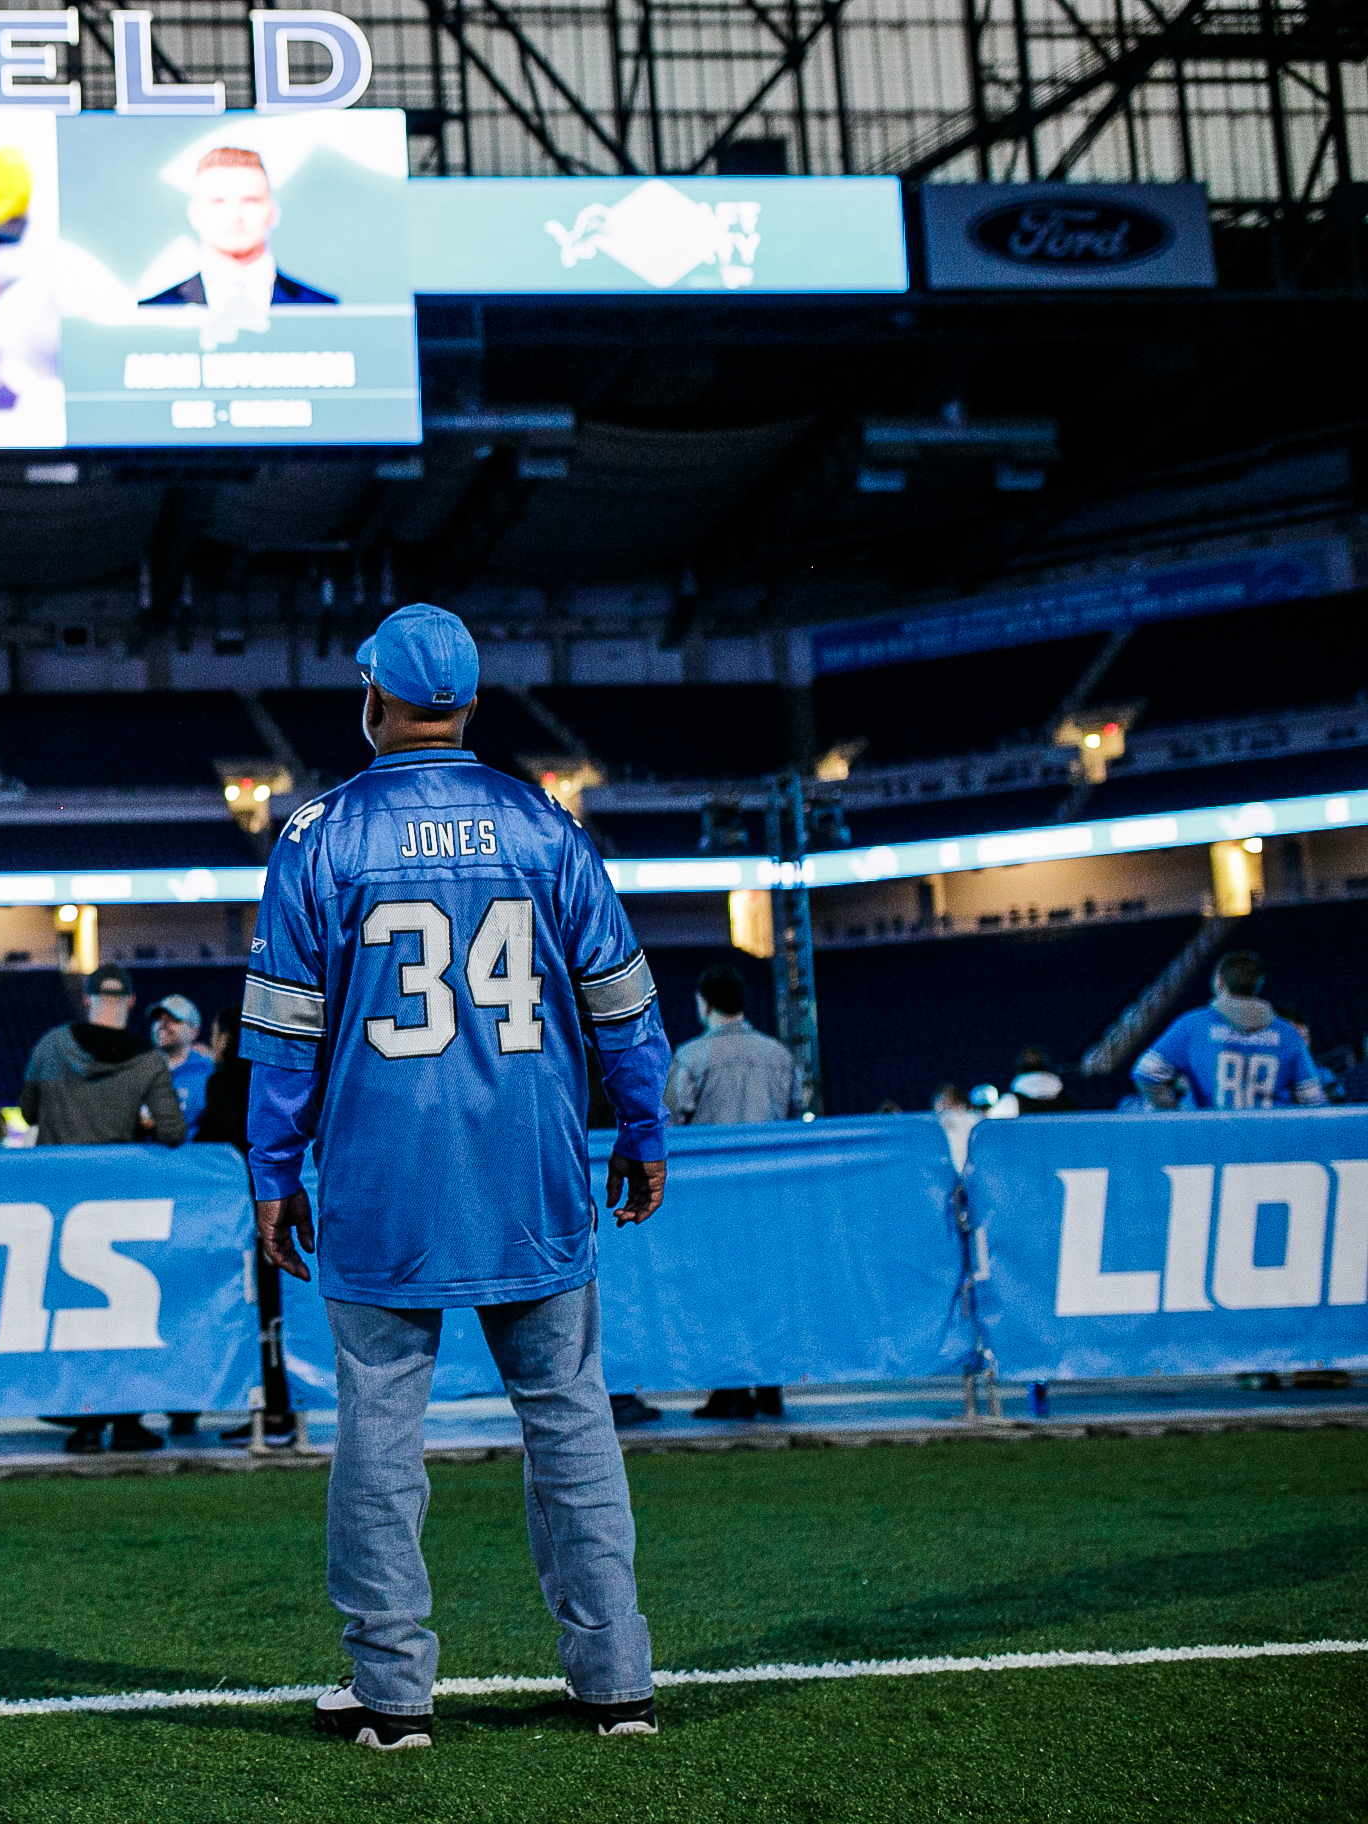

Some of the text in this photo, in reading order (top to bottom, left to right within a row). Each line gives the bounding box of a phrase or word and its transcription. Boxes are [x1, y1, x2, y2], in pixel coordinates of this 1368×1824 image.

[1007, 204, 1133, 258] Ford
[401, 817, 498, 859] JONES
[361, 898, 544, 1060] 34
[1055, 1158, 1368, 1317] LIO
